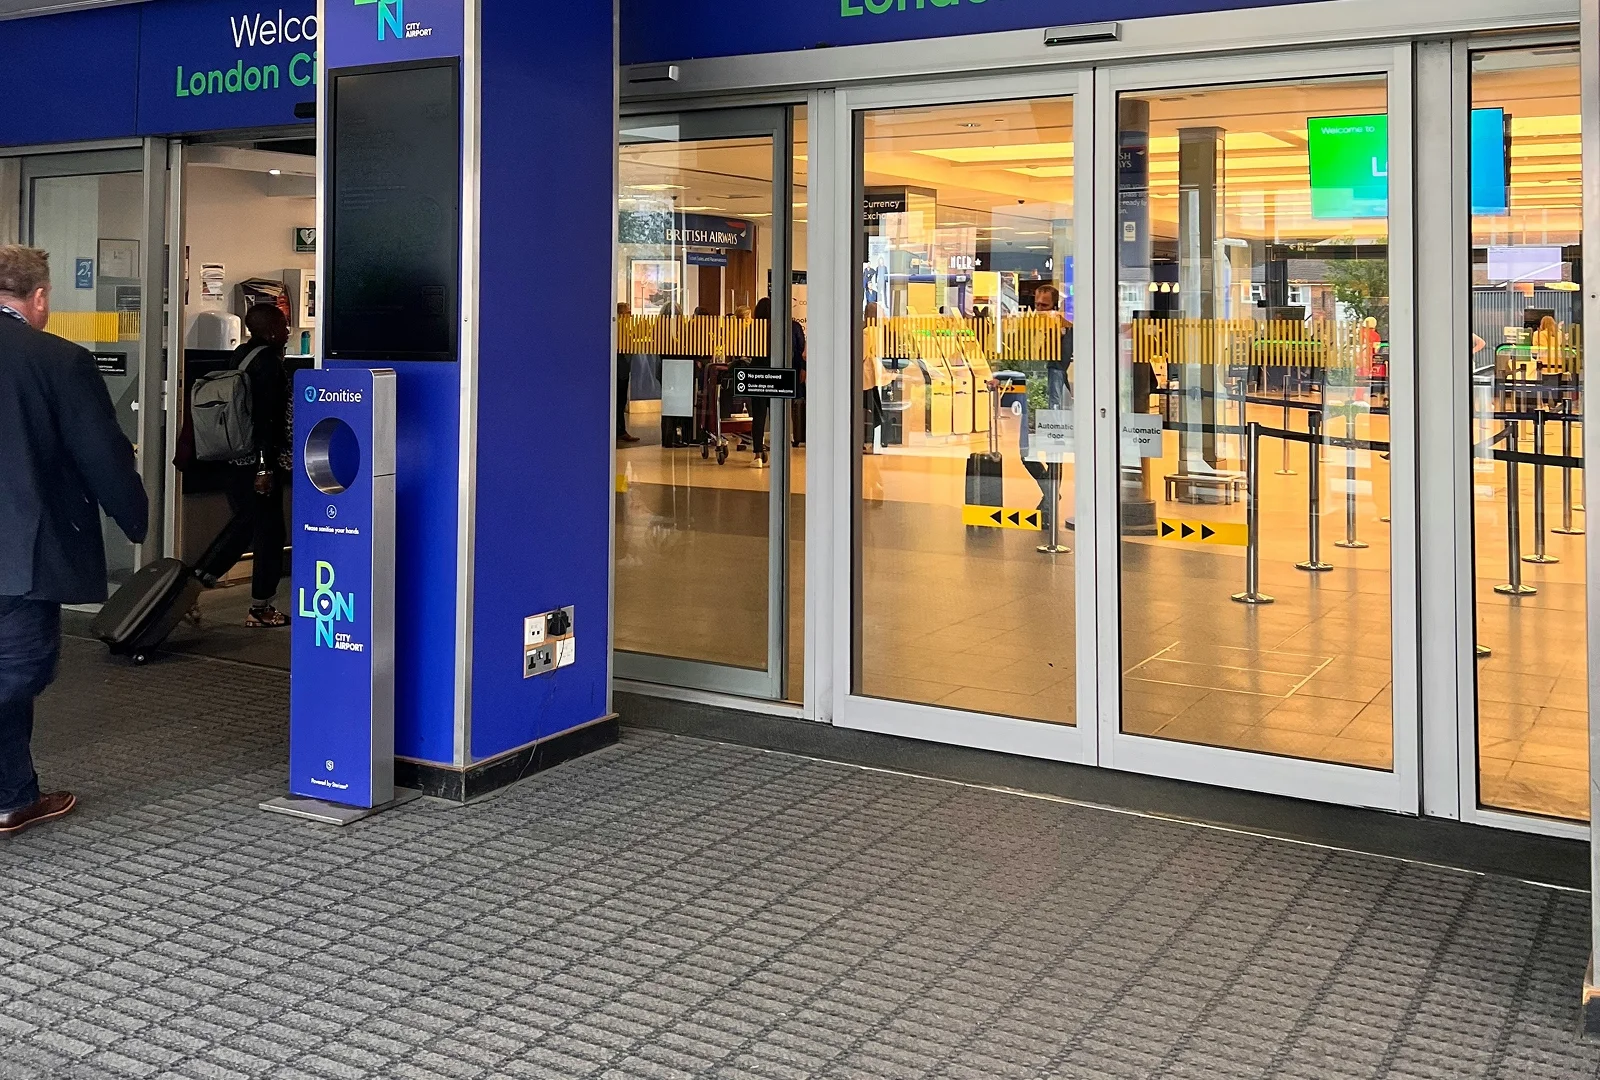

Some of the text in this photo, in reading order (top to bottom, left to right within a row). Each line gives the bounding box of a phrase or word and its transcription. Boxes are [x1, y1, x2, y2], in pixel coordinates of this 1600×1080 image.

[230, 8, 318, 48] Welco
[405, 22, 420, 31] CITY
[405, 28, 432, 38] AIRPORT
[176, 59, 279, 97] London
[1321, 125, 1375, 135] Welcome to
[863, 200, 900, 209] Currency
[665, 229, 737, 245] BRITISH AIRWAYS
[949, 255, 975, 270] NGER
[1006, 305, 1040, 319] ATM
[318, 388, 363, 403] Zonitise
[1037, 422, 1074, 431] Automatic
[1122, 426, 1161, 435] Automatic
[1046, 432, 1065, 440] door
[304, 523, 319, 532] Please
[345, 526, 360, 535] hands
[334, 632, 351, 642] CITY
[334, 641, 364, 652] AIRPORT
